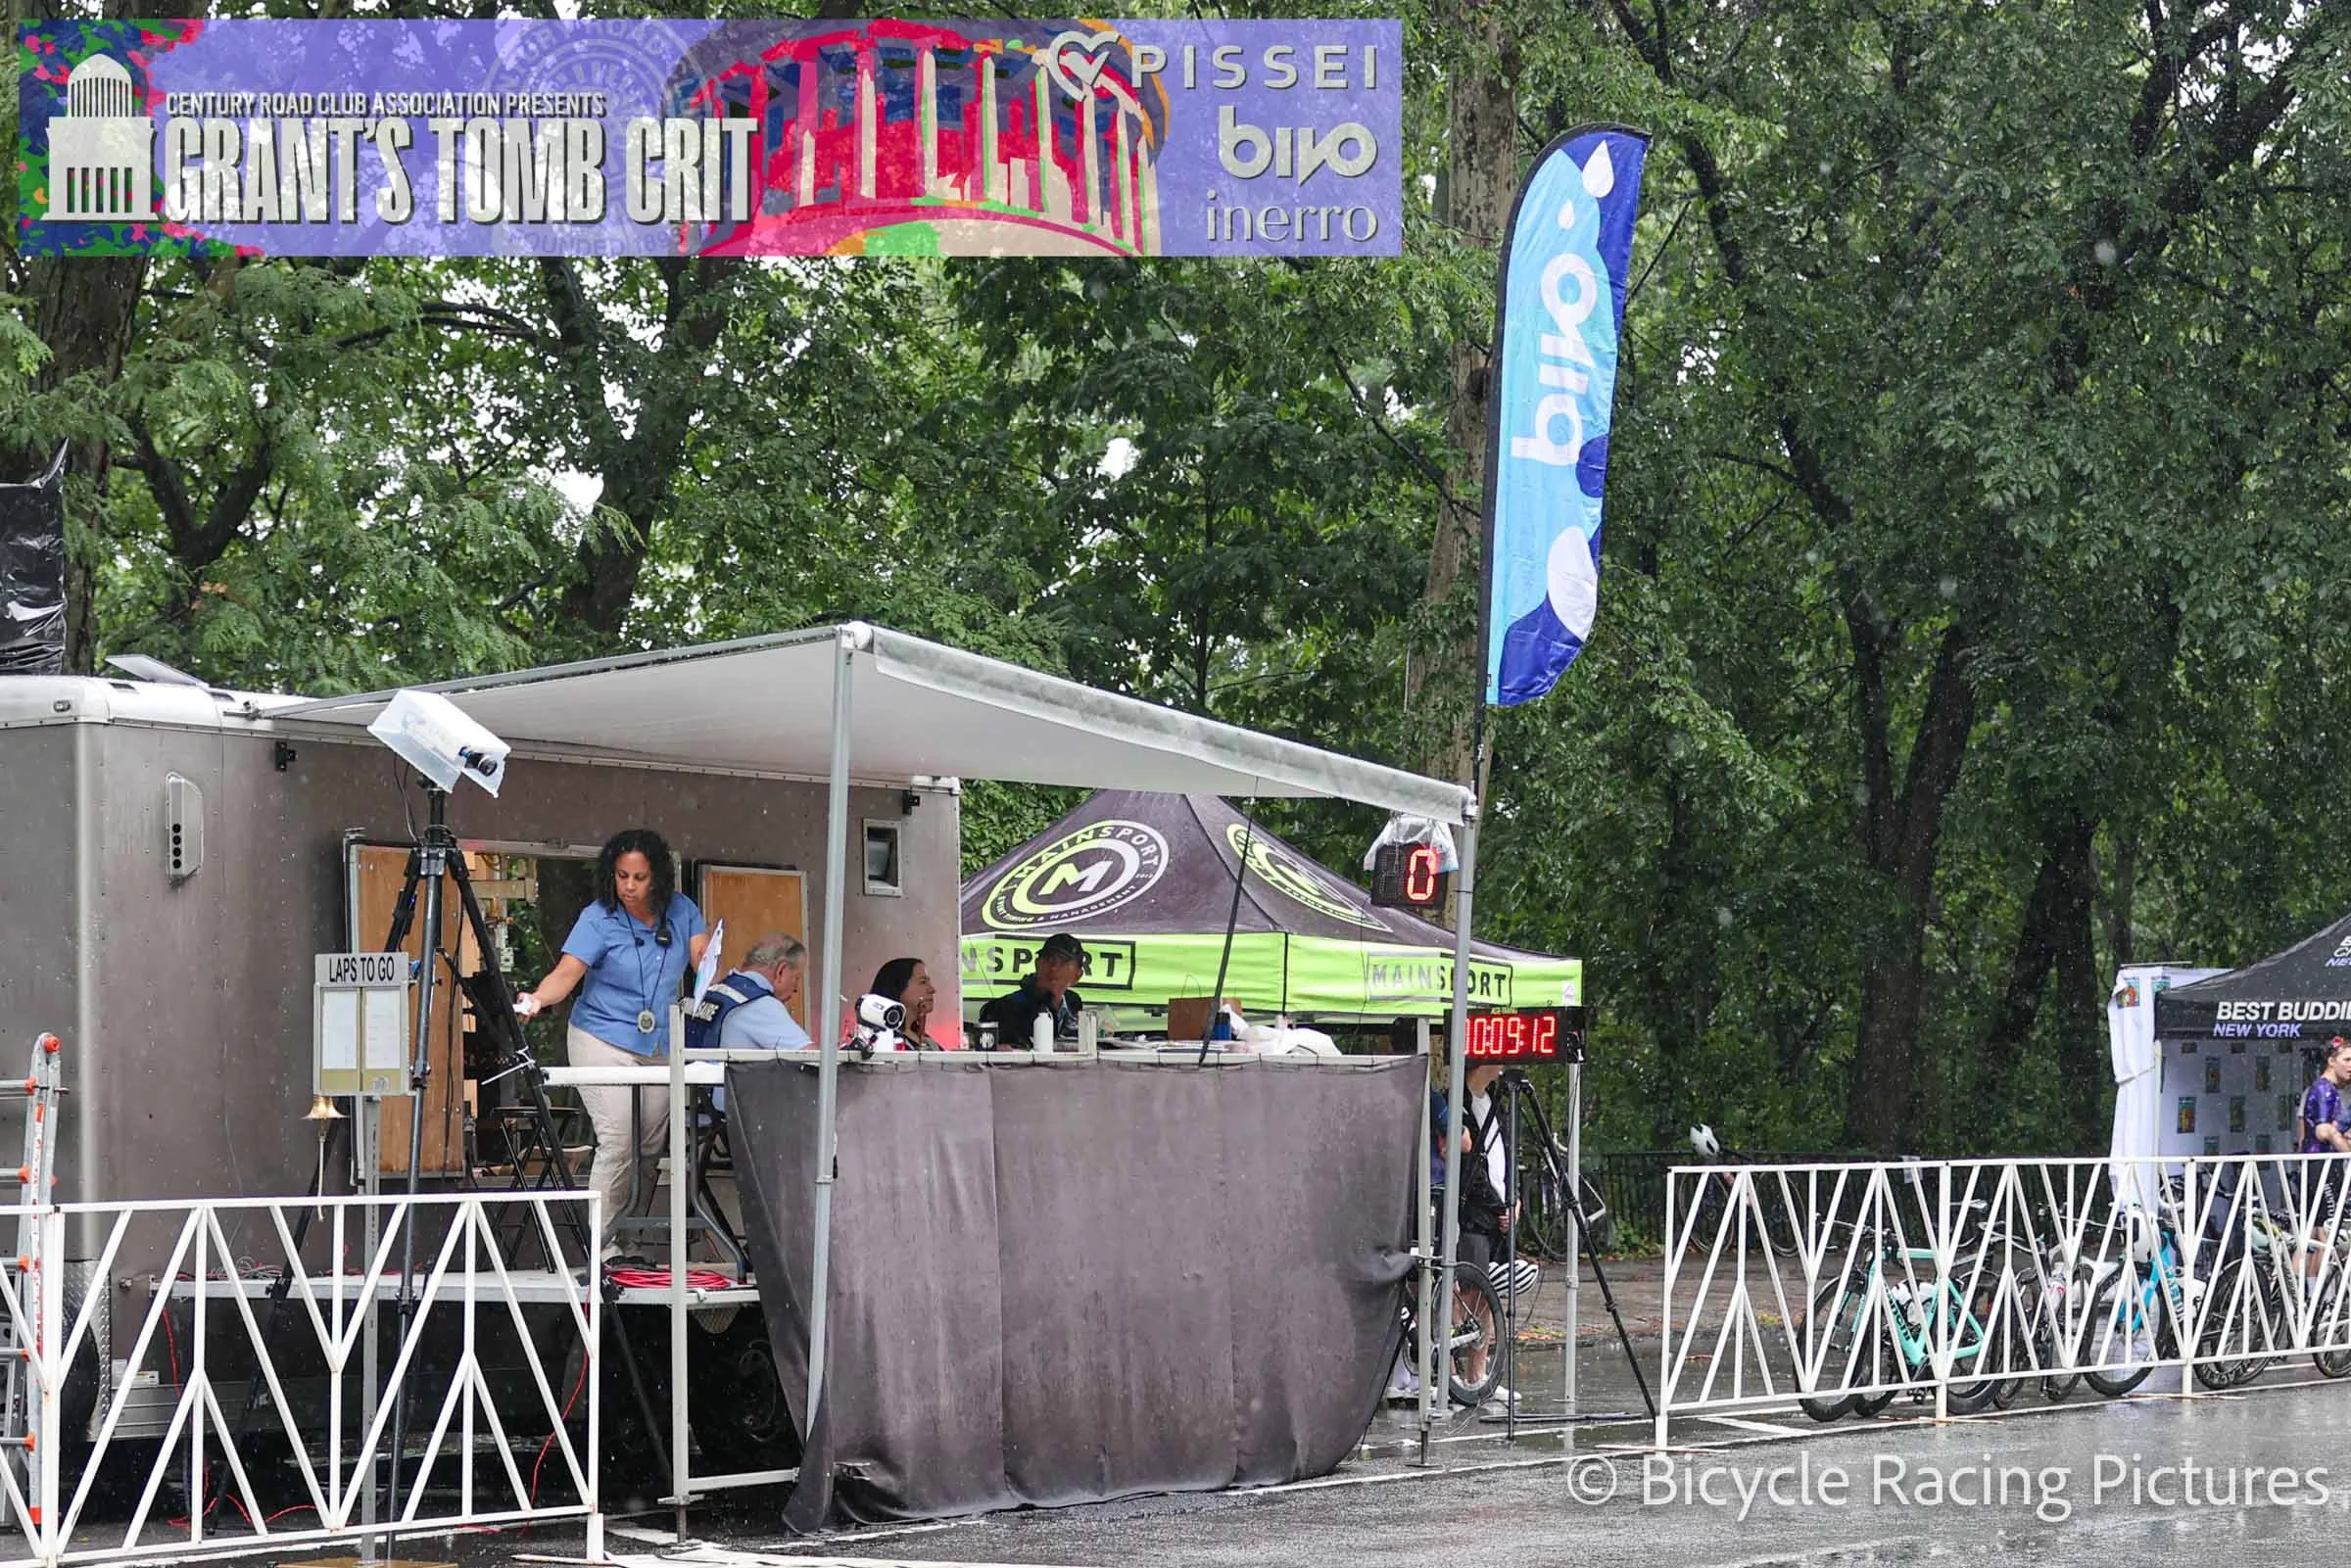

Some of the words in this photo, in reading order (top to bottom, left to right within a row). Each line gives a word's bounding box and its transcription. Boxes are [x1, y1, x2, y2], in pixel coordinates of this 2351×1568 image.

[1511, 252, 1598, 467] bivo
[1014, 826, 1160, 879] MAINSPORT
[1049, 884, 1136, 921] MANAGEMENT
[329, 956, 359, 982] LAPS
[360, 956, 375, 982] TO
[377, 956, 395, 982] GO
[1372, 964, 1507, 998] MAINSORT
[2216, 1001, 2276, 1022] BEST
[1463, 1016, 1556, 1055] 0:09:12
[2213, 1023, 2252, 1037] NEW
[2256, 1022, 2303, 1038] YORK
